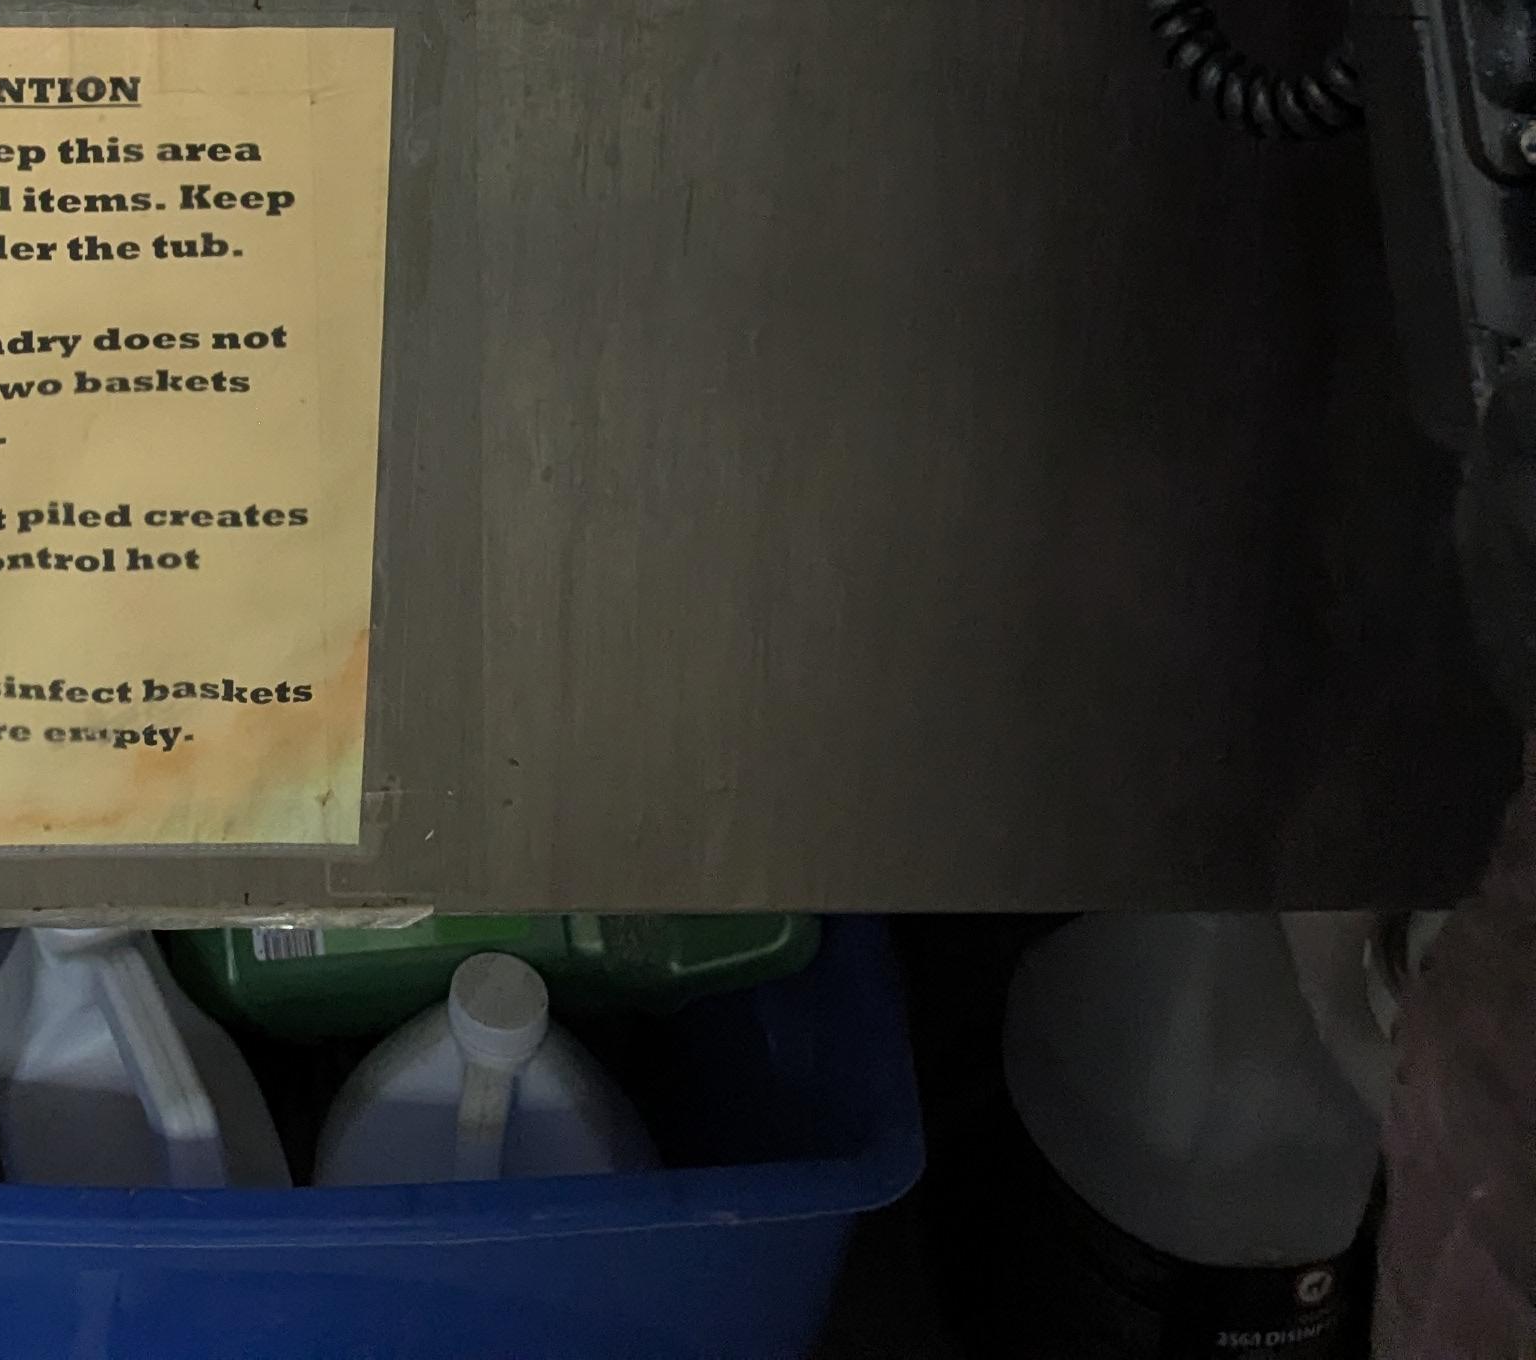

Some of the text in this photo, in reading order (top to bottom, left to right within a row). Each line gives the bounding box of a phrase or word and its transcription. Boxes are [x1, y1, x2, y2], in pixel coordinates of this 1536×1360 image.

[57, 136, 145, 165] this
[156, 142, 262, 162] area
[22, 186, 167, 214] items.
[179, 184, 296, 217] Keep
[66, 235, 141, 262] the
[151, 231, 243, 260] tub.
[93, 327, 201, 352] does
[211, 325, 287, 350] not
[73, 369, 251, 394] baskets
[17, 500, 133, 534] piled
[143, 503, 309, 528] creates
[126, 547, 200, 572] hot
[142, 678, 313, 705] baskets
